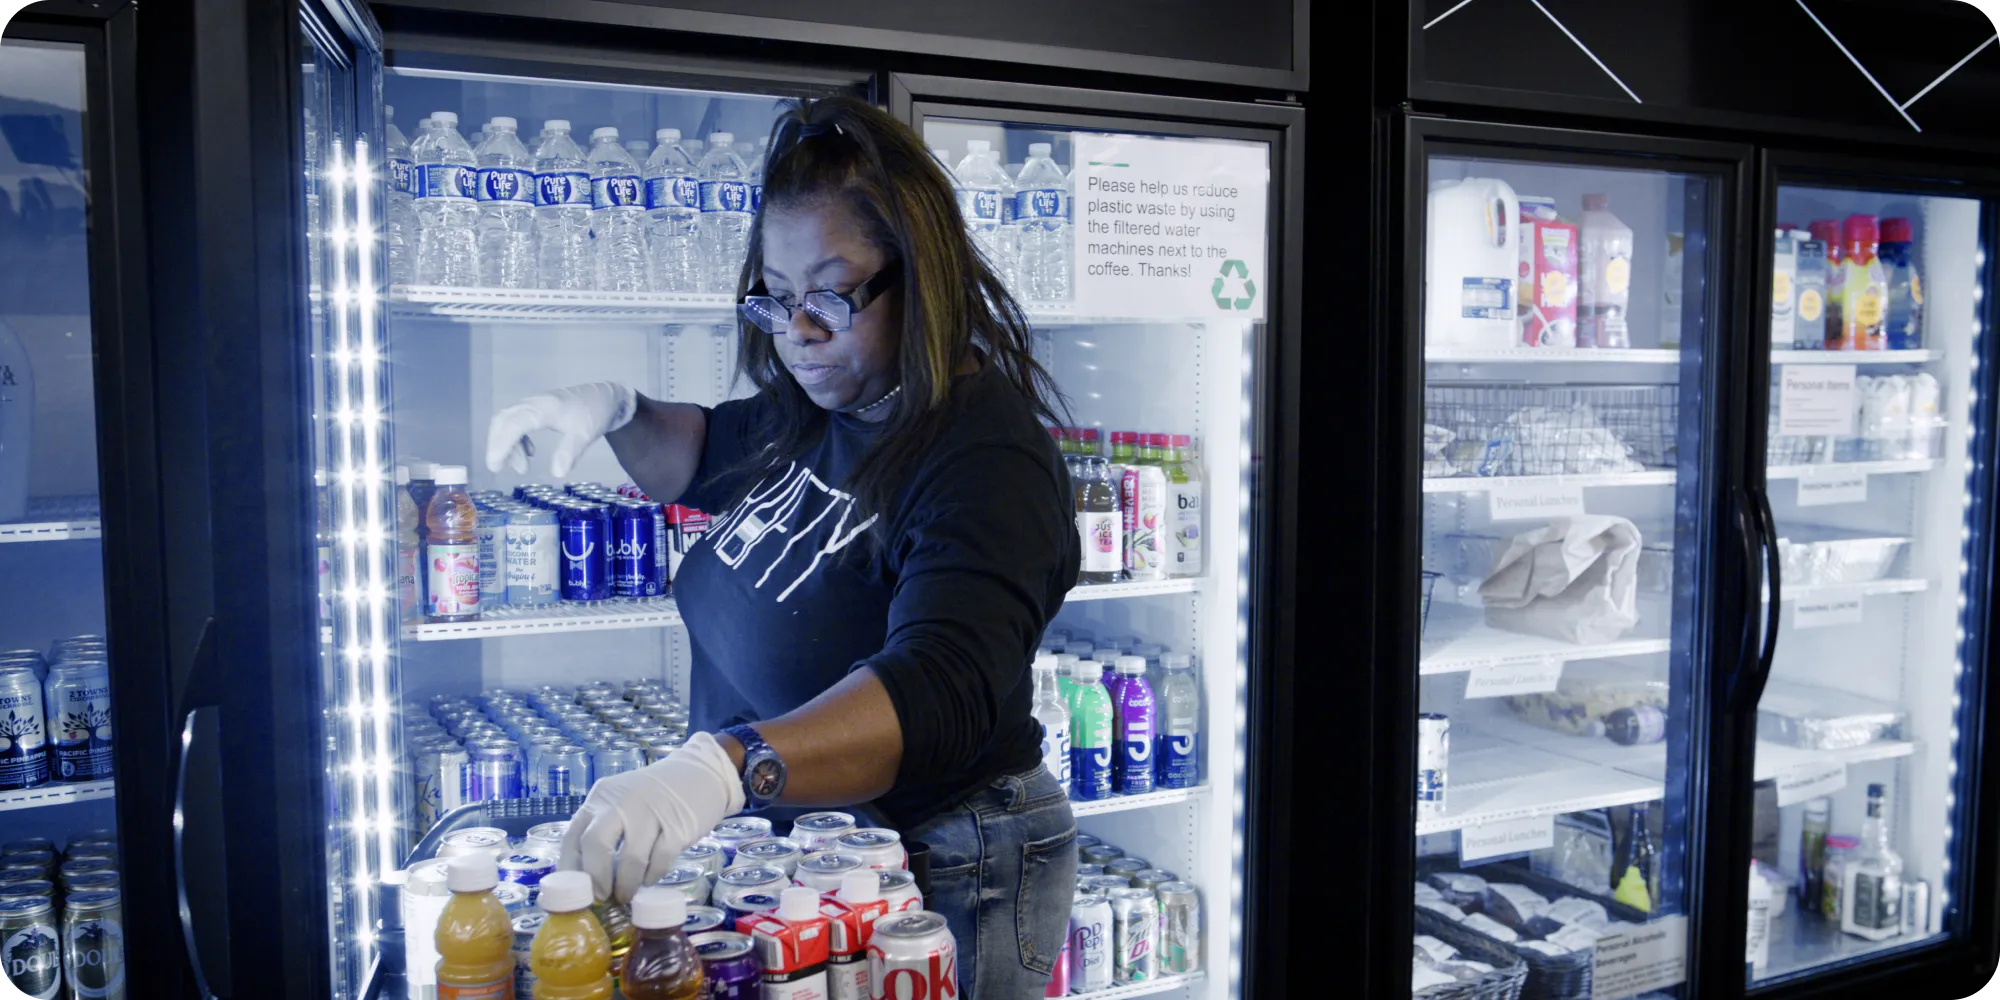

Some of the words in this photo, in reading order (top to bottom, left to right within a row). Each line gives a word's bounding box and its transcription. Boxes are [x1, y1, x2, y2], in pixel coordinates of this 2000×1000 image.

[390, 160, 410, 172] Pure
[393, 170, 408, 182] Life
[490, 170, 514, 182] Pure
[544, 176, 566, 187] Pure
[493, 180, 512, 192] Life
[547, 184, 565, 196] Life
[611, 178, 632, 190] Pure
[678, 178, 696, 190] Pure
[724, 182, 744, 194] Pure
[1088, 176, 1136, 194] Please
[1140, 180, 1168, 197] help
[1173, 185, 1188, 196] us
[1192, 184, 1238, 198] reduce
[615, 186, 631, 198] Life
[680, 187, 695, 198] Life
[726, 192, 742, 203] Life
[978, 191, 997, 201] Pure
[1036, 190, 1056, 200] Pure
[980, 200, 996, 210] Life
[1038, 198, 1054, 208] Life
[1088, 198, 1132, 215] plastic
[1136, 204, 1176, 216] waste
[1180, 202, 1196, 220] by
[1200, 204, 1235, 222] using
[1088, 220, 1109, 234] the
[1114, 220, 1160, 236] filtered
[1164, 224, 1200, 236] water
[1088, 241, 1154, 256] machines
[1158, 244, 1186, 257] next
[1191, 244, 1202, 257] to
[1207, 244, 1227, 258] the
[1088, 262, 1133, 276] coffee.
[1138, 263, 1192, 277] Thanks!
[1786, 378, 1825, 391] Personal
[1496, 496, 1536, 509] Personal
[1466, 832, 1506, 848] Personal
